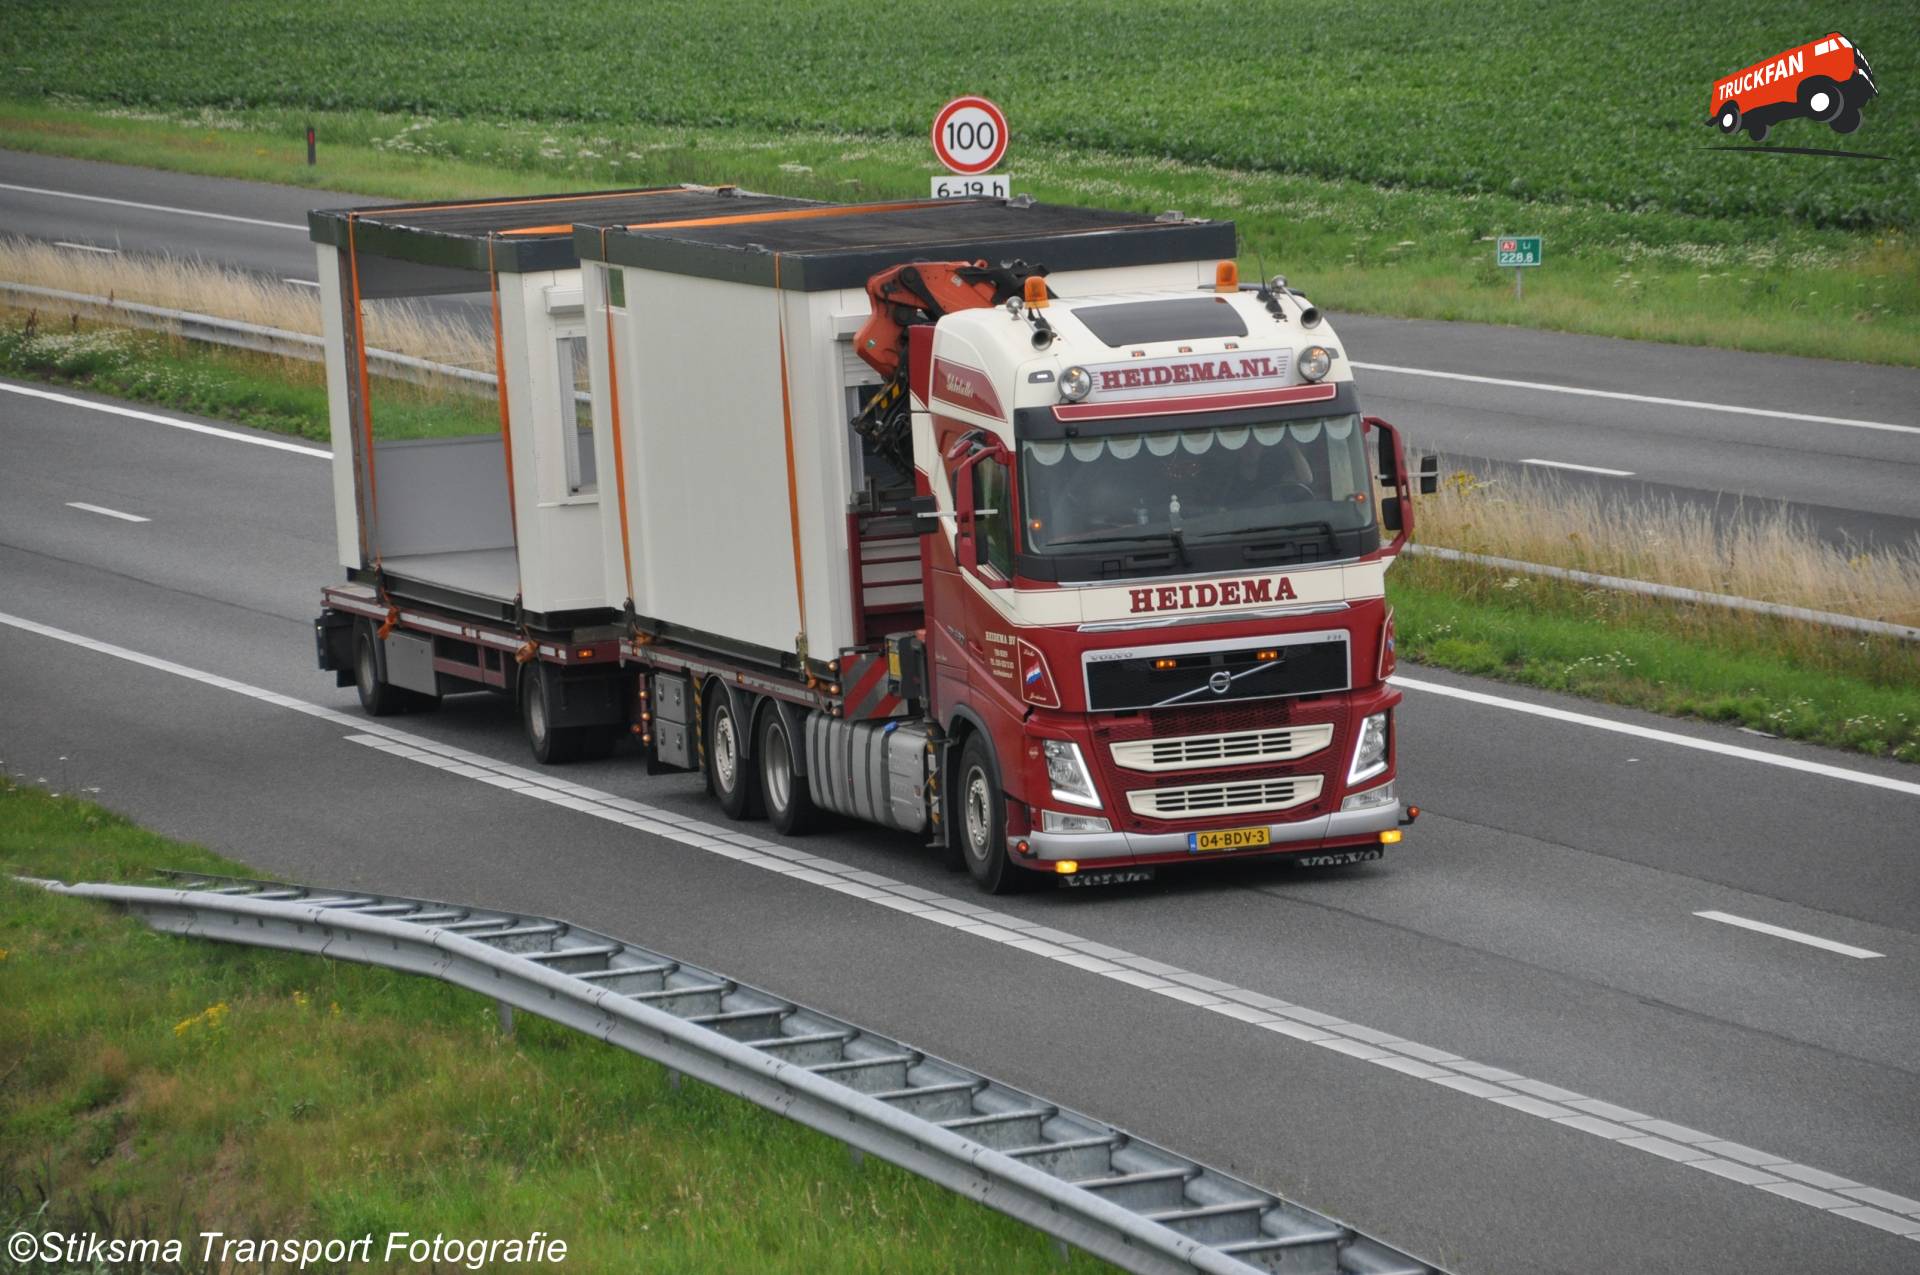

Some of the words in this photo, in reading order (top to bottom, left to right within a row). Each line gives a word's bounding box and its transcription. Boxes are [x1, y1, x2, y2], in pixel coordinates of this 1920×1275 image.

[947, 121, 994, 150] 100
[937, 181, 984, 198] 6-19
[992, 181, 1004, 197] h
[1100, 357, 1279, 389] HEIDEMA.NL
[1129, 576, 1297, 613] HEIDEMA
[1200, 830, 1265, 848] 04-BDV-3
